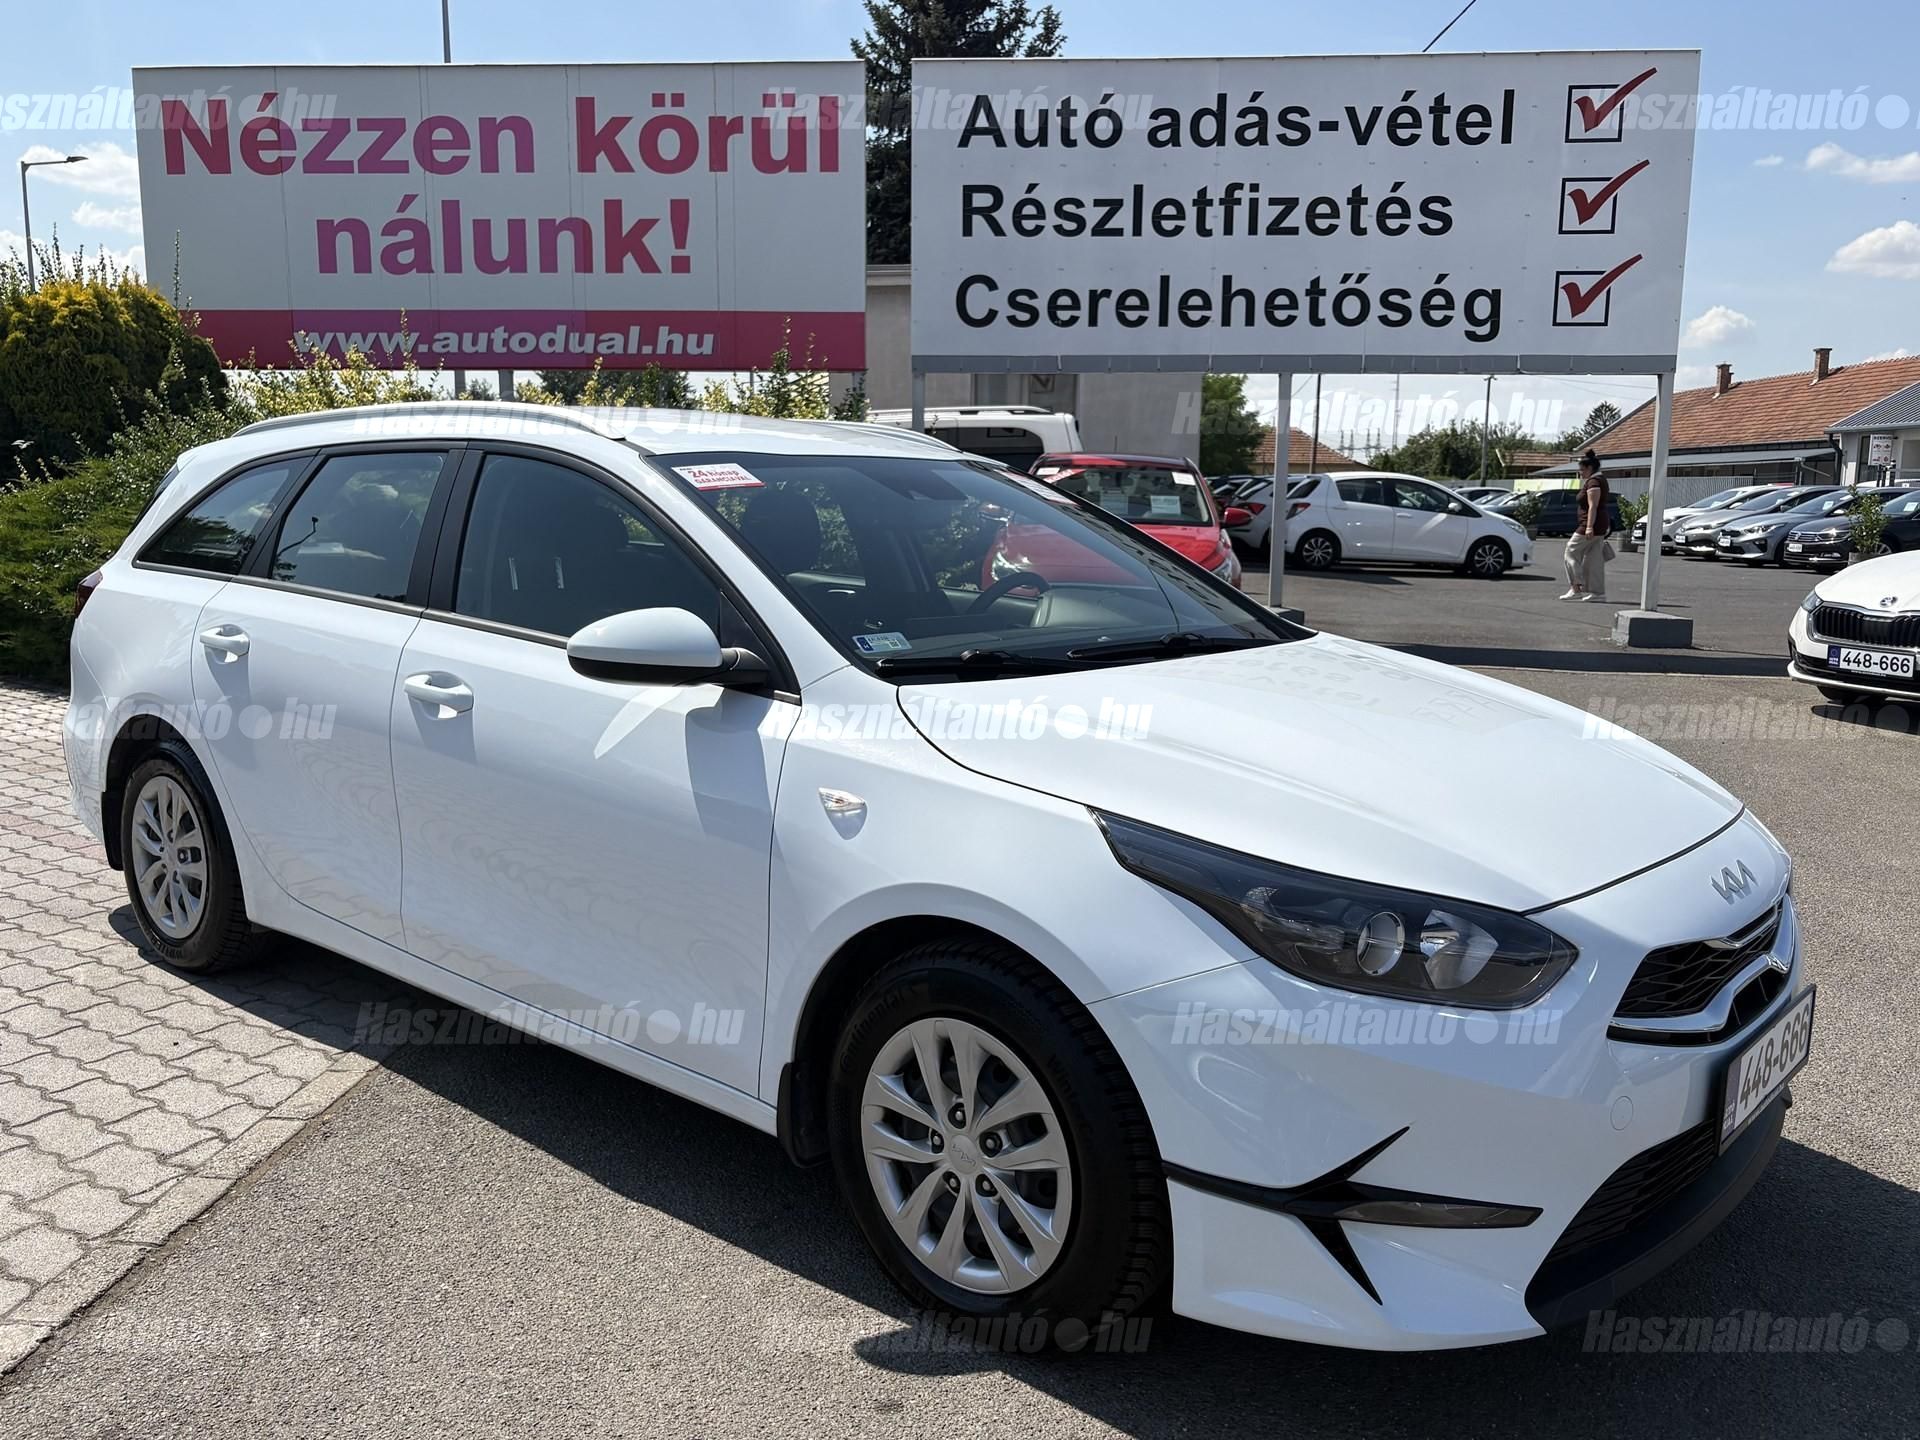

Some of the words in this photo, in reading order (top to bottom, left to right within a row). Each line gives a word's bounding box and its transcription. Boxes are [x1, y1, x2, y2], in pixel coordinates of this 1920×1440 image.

[161, 92, 535, 176] Nézzen
[576, 92, 840, 174] körül
[957, 93, 1124, 149] Autó
[1147, 89, 1515, 149] adás-vétel
[316, 194, 694, 276] nálunk!
[962, 181, 1454, 238] Részletfizetés
[955, 272, 1503, 342] Cserelehetőség
[292, 325, 715, 356] www.autodual.hu
[1842, 650, 1911, 674] 448-666
[1739, 1001, 1811, 1110] 448-666
